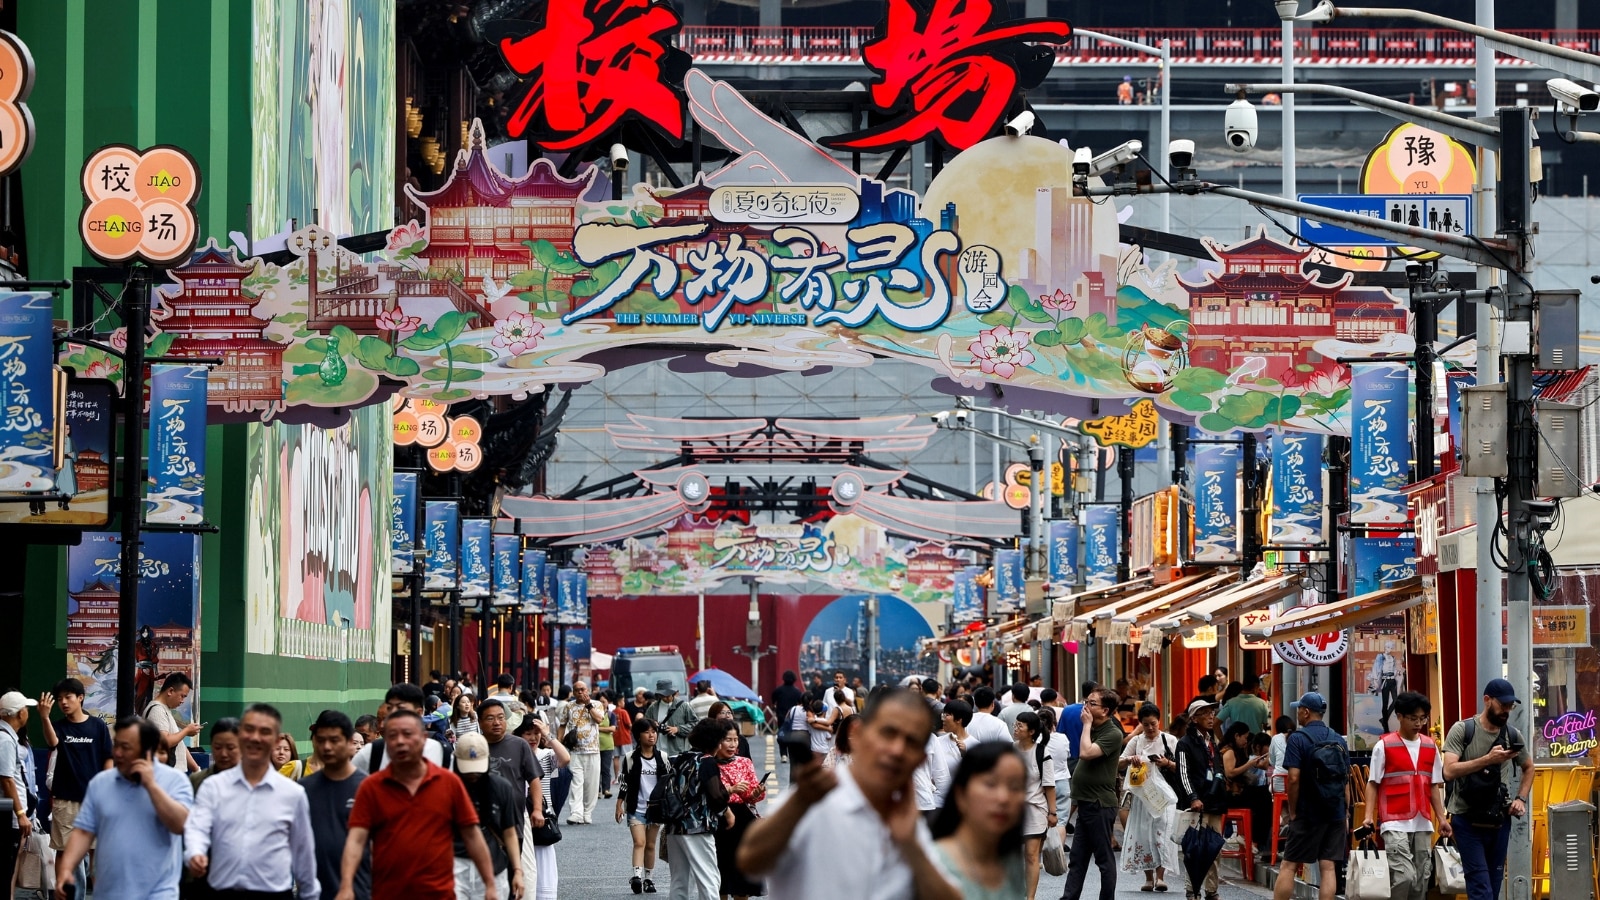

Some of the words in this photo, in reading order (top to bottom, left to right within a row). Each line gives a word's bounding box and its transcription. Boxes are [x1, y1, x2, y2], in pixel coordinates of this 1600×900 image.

[1404, 135, 1437, 167] 豫
[101, 163, 131, 192] 校
[147, 176, 181, 188] JIAO
[1414, 181, 1428, 189] YU
[88, 220, 142, 233] CHANG
[149, 214, 176, 241] 场
[561, 223, 960, 330] 万物有灵
[963, 250, 998, 310] 游园会
[615, 313, 641, 324] THE
[645, 313, 699, 324] SUMMER
[728, 313, 806, 324] YU-NIVERSE
[421, 420, 437, 436] 场
[459, 448, 474, 462] 场
[1305, 650, 1336, 661] WELFARE
[1543, 709, 1598, 739] Cocktails
[1569, 733, 1578, 743] &
[1549, 736, 1598, 757] Dreams
